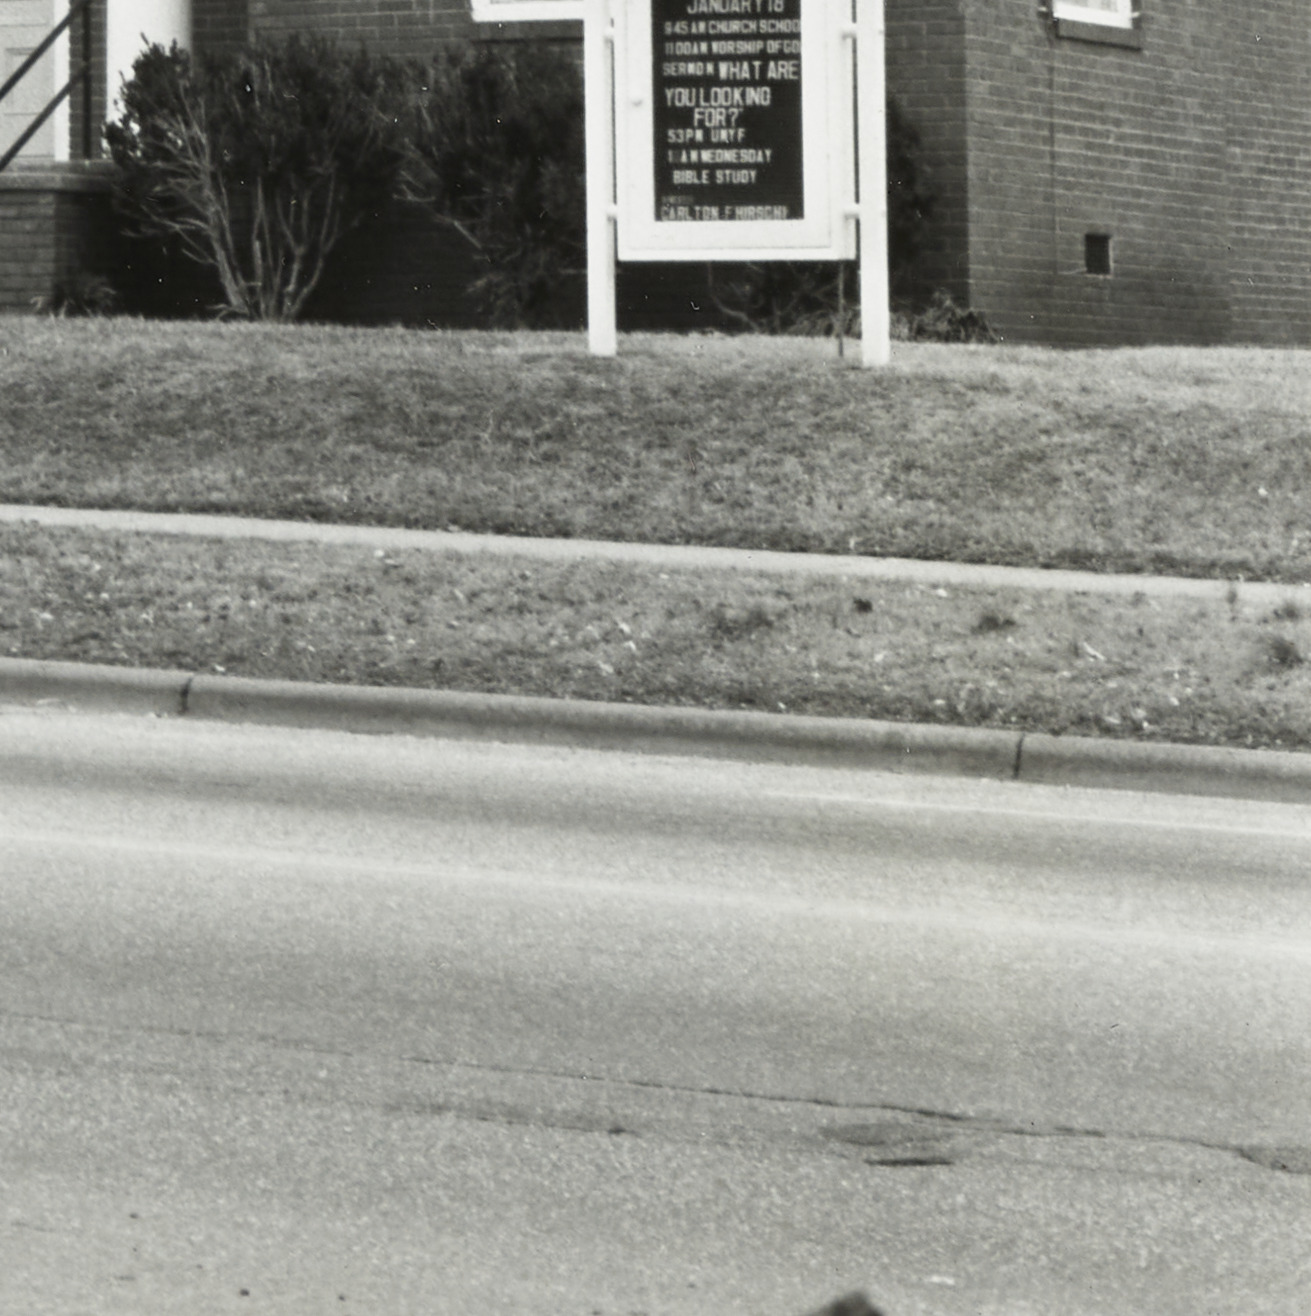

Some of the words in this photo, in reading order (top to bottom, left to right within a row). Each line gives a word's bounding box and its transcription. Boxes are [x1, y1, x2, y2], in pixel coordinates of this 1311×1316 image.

[708, 19, 758, 34] CHURCH
[711, 40, 764, 54] WORSHIP
[663, 61, 714, 76] SERMON
[718, 60, 762, 80] WHAT
[767, 60, 800, 80] ARE
[665, 87, 696, 107] YOU
[700, 149, 772, 163] WEDNESDAY
[673, 169, 710, 184] BIBLE
[715, 169, 757, 184] STUDY
